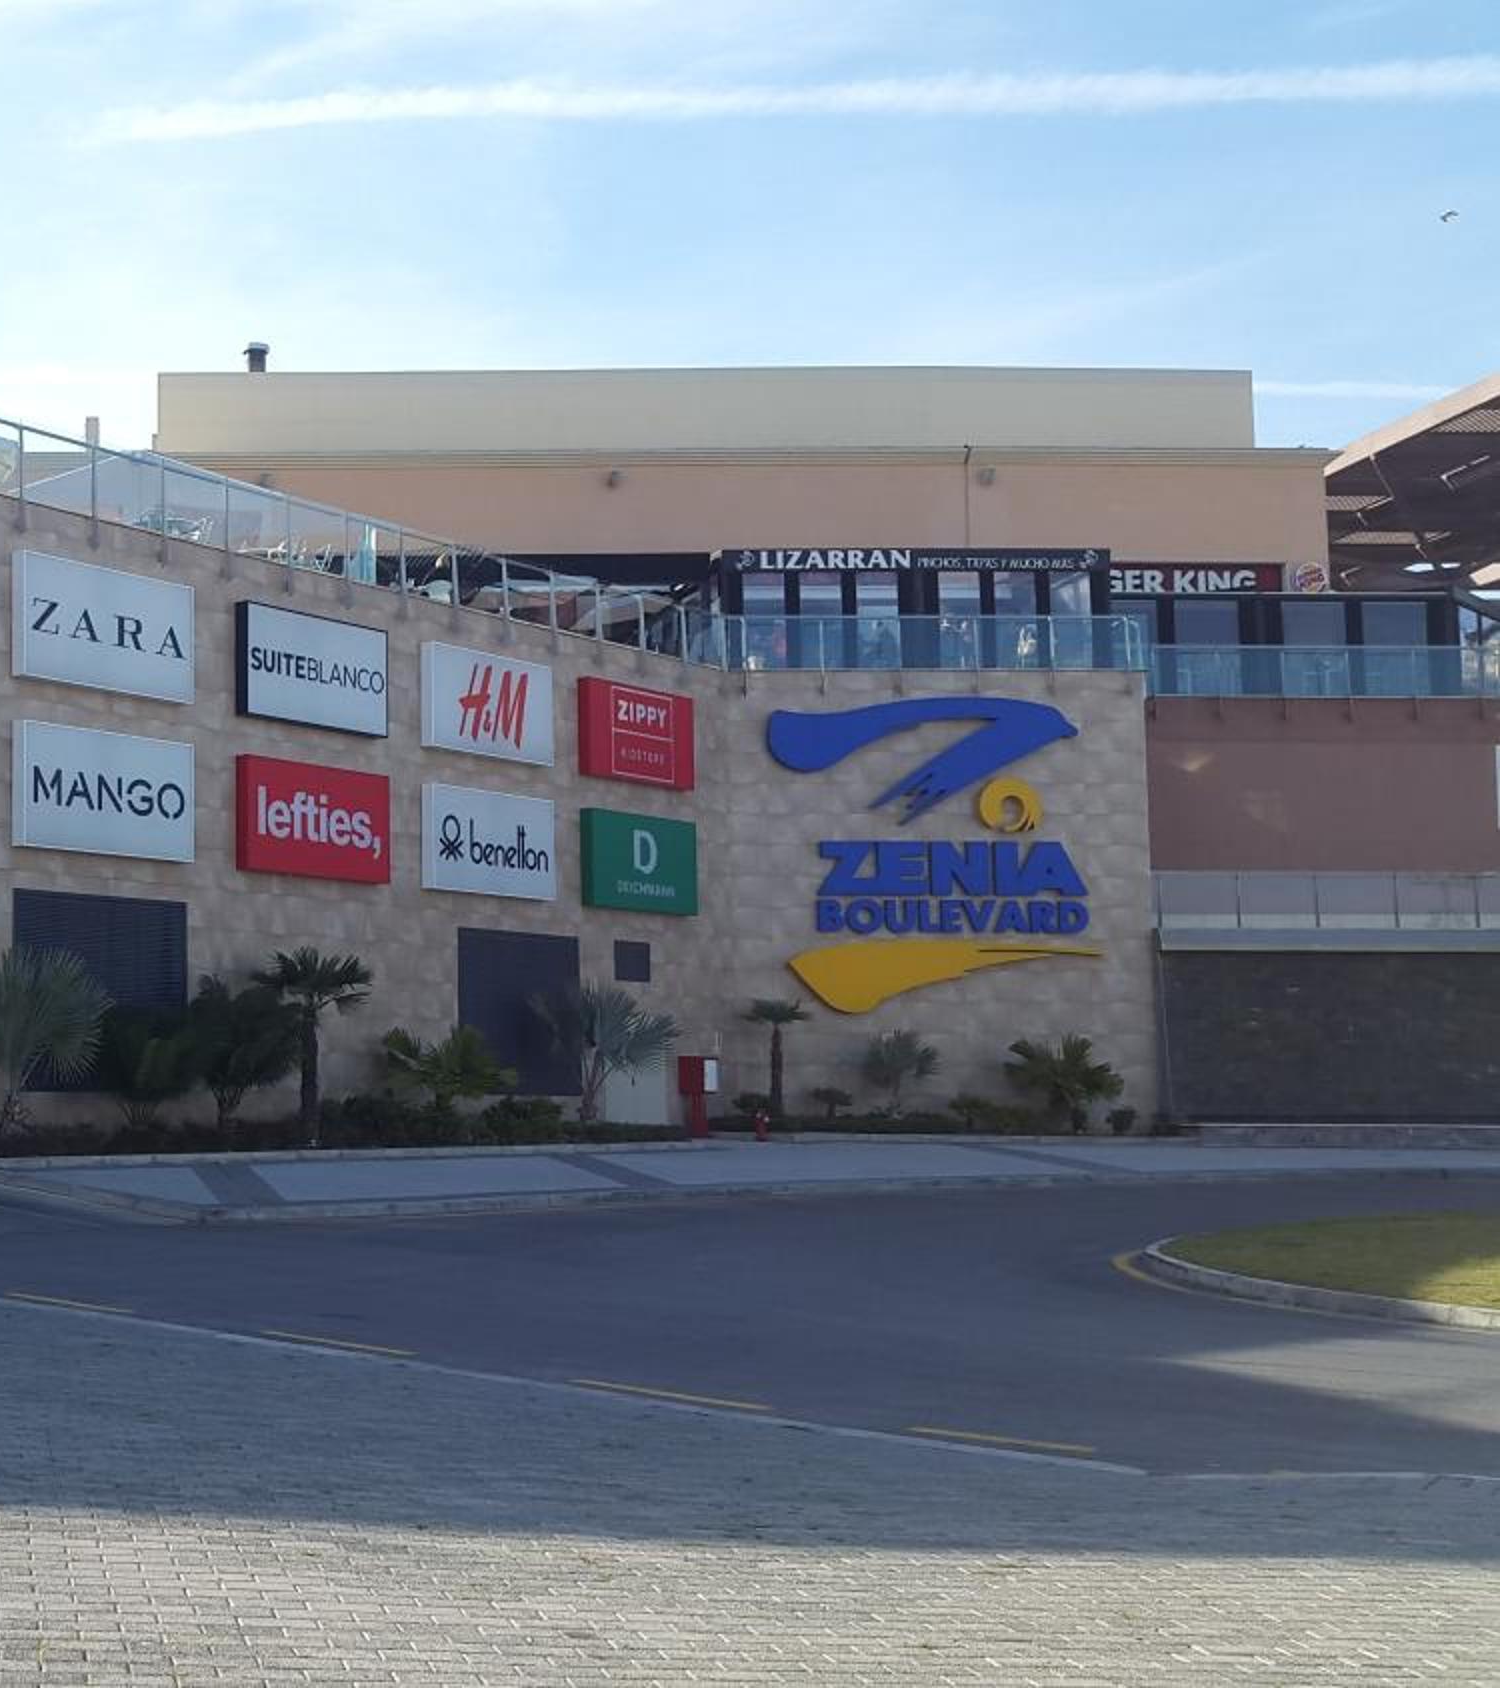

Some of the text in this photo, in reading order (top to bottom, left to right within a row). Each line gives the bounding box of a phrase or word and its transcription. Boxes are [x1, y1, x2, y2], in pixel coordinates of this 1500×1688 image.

[759, 550, 912, 570] LIZARRAN
[1173, 570, 1257, 593] KING
[30, 597, 188, 661] ZARA
[250, 646, 384, 695] SUITEBLANCO
[458, 662, 529, 750] H&M
[618, 700, 666, 728] ZIPPY
[32, 765, 185, 819] MANGO
[469, 819, 550, 873] benetton
[633, 829, 657, 874] D
[816, 840, 1089, 897] ZENIA
[816, 899, 1089, 934] BOULEVARD
